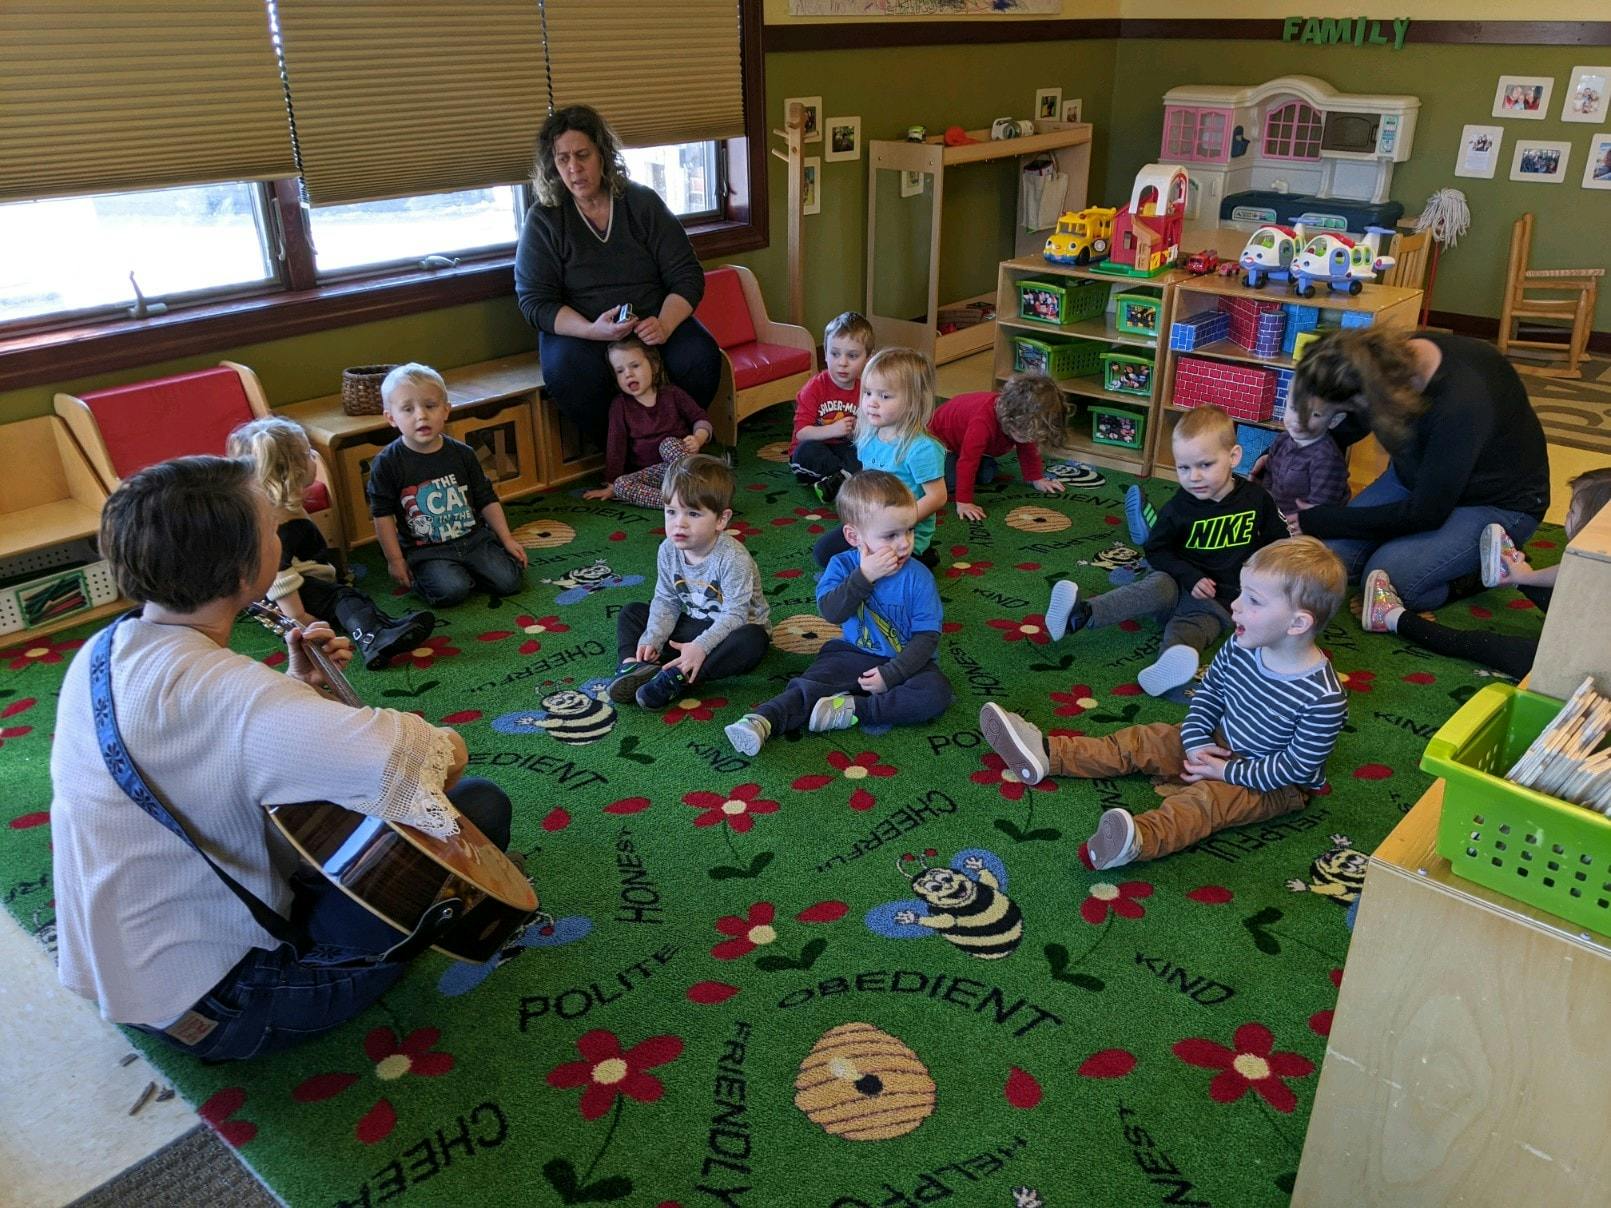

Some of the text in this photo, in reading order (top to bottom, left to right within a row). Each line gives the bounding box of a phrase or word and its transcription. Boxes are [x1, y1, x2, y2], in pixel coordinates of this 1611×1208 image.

[1282, 16, 1410, 49] FAMILY
[426, 485, 468, 515] CAT
[431, 474, 457, 489] THE
[453, 511, 472, 520] THE
[1185, 510, 1256, 549] NIKE
[972, 588, 1029, 608] KIND
[949, 640, 1010, 697] HONEST
[468, 752, 609, 791] EDIENT
[687, 742, 751, 772] KIND
[816, 790, 958, 873] CHEERFUL
[614, 825, 663, 925] HONEST
[518, 943, 685, 1032] POLITE
[1135, 951, 1235, 1005] KIND
[778, 970, 1063, 1038] OBEDIENT
[695, 1020, 753, 1208] FRIENDLY
[1117, 1098, 1213, 1208] NEST
